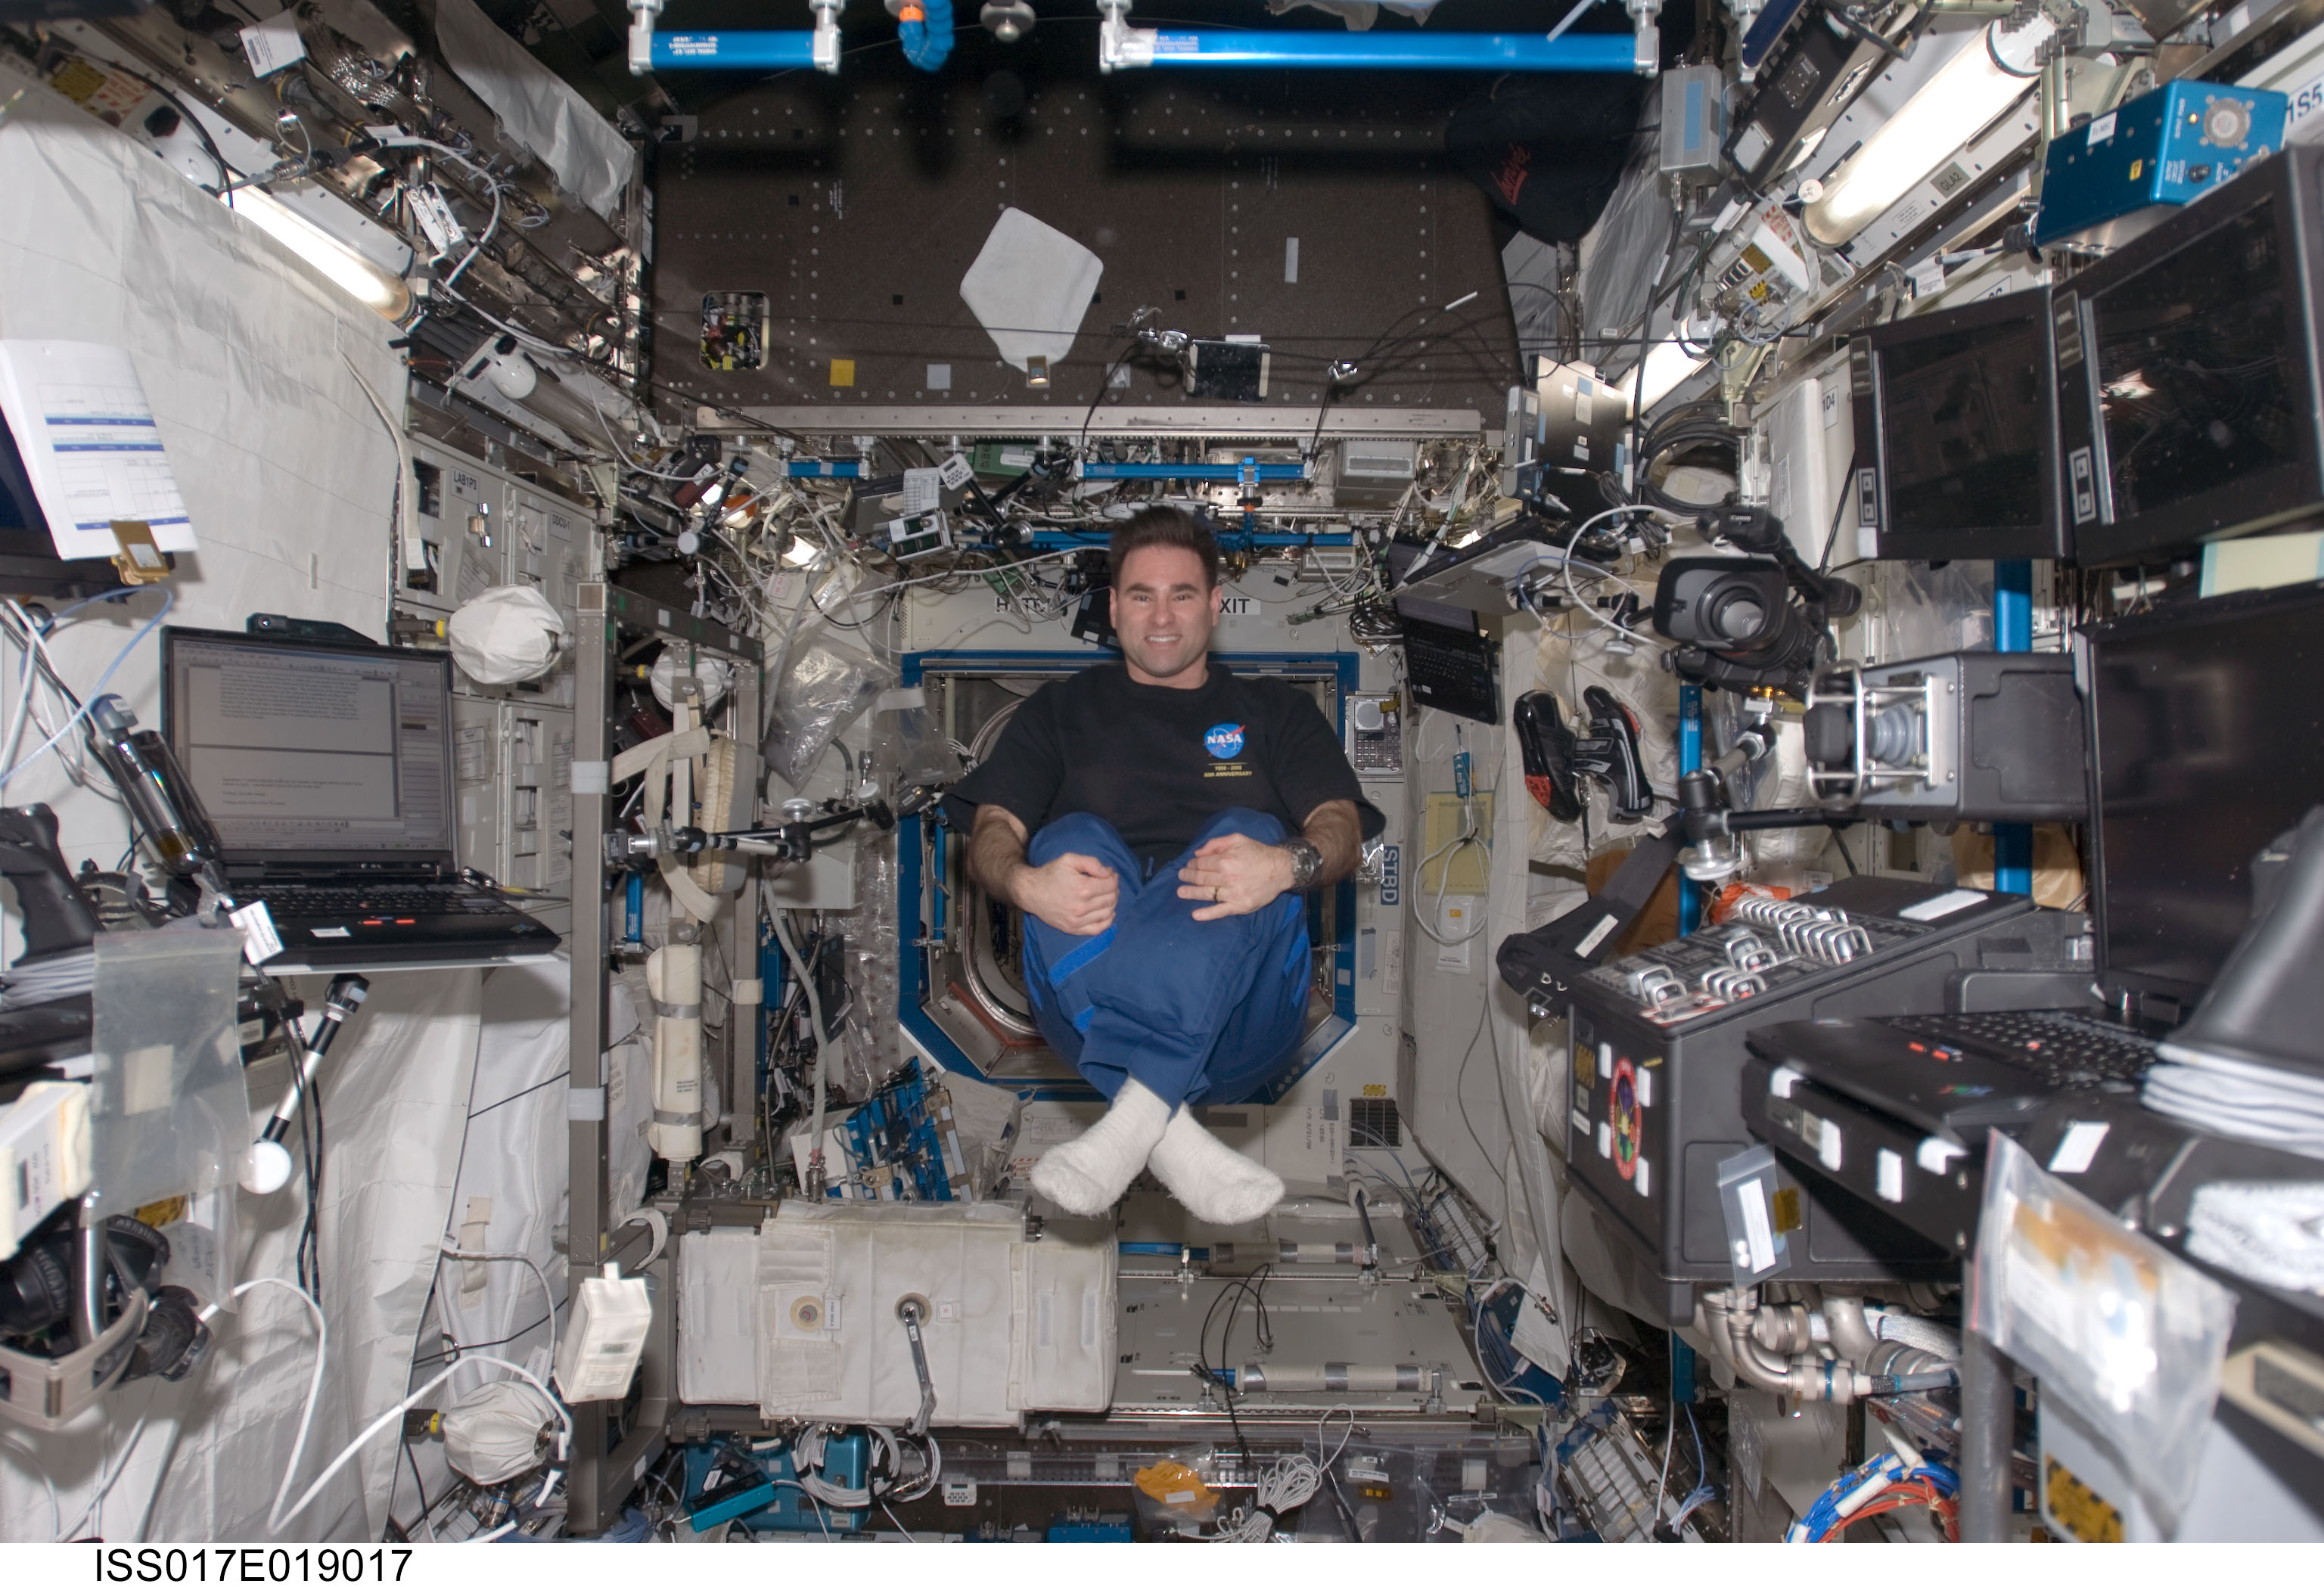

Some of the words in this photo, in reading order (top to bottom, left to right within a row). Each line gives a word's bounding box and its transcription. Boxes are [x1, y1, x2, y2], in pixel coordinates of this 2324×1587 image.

[1940, 172, 1962, 191] GLA2
[1822, 393, 1835, 412] 1D4
[454, 471, 477, 491] LAB1P3
[551, 514, 570, 528] DDCU-1
[1219, 598, 1251, 614] XIT
[1207, 733, 1242, 744] NASA
[1382, 849, 1398, 902] STBD
